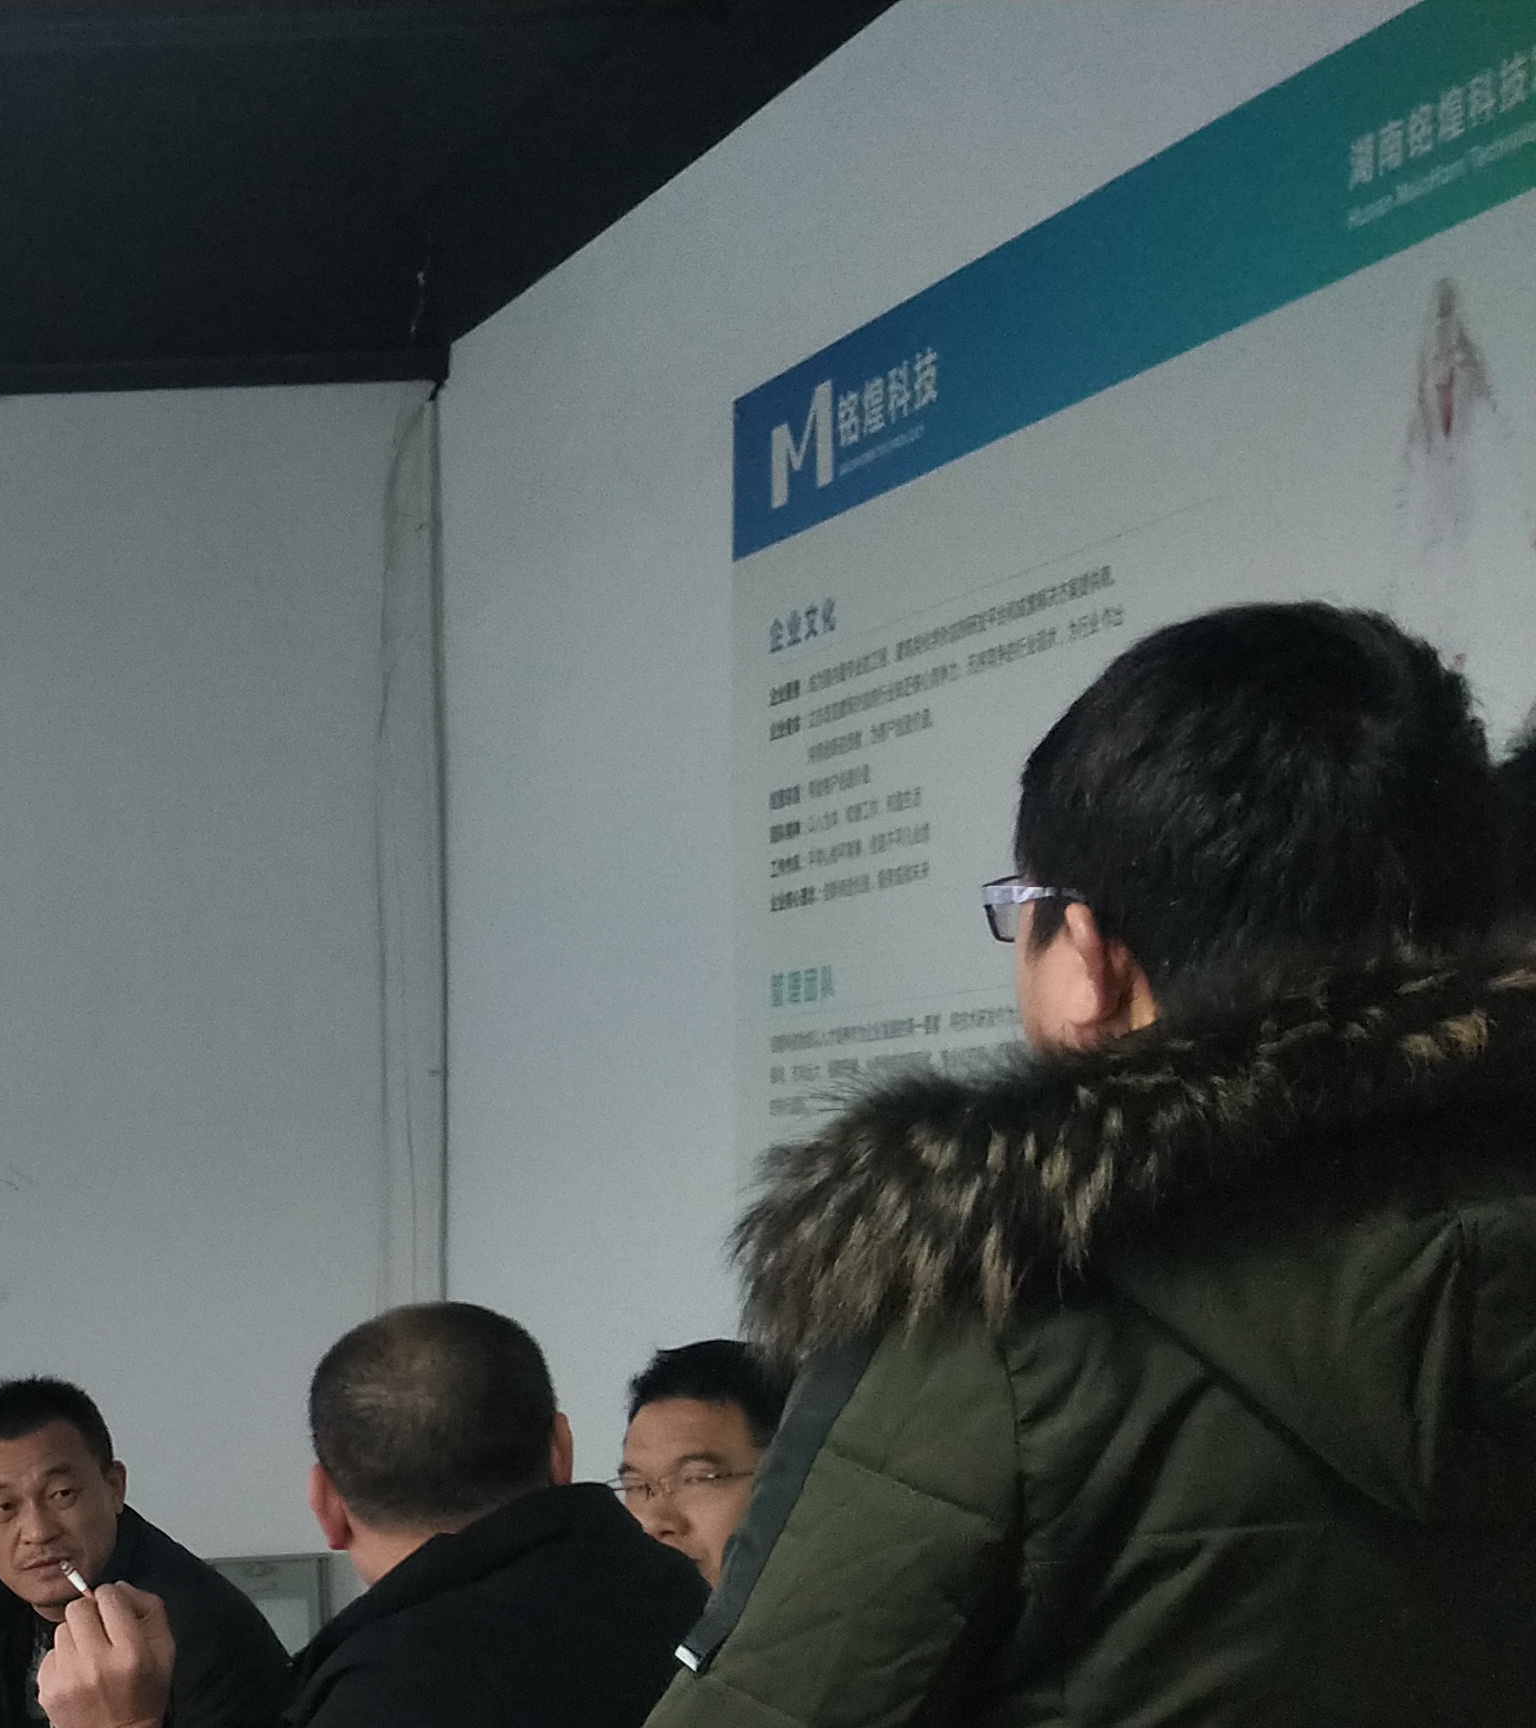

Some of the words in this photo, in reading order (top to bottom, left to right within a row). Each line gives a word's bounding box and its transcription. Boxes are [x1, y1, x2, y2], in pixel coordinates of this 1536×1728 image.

[1348, 45, 1536, 192] 湖南铭煌科技
[770, 378, 835, 510] M
